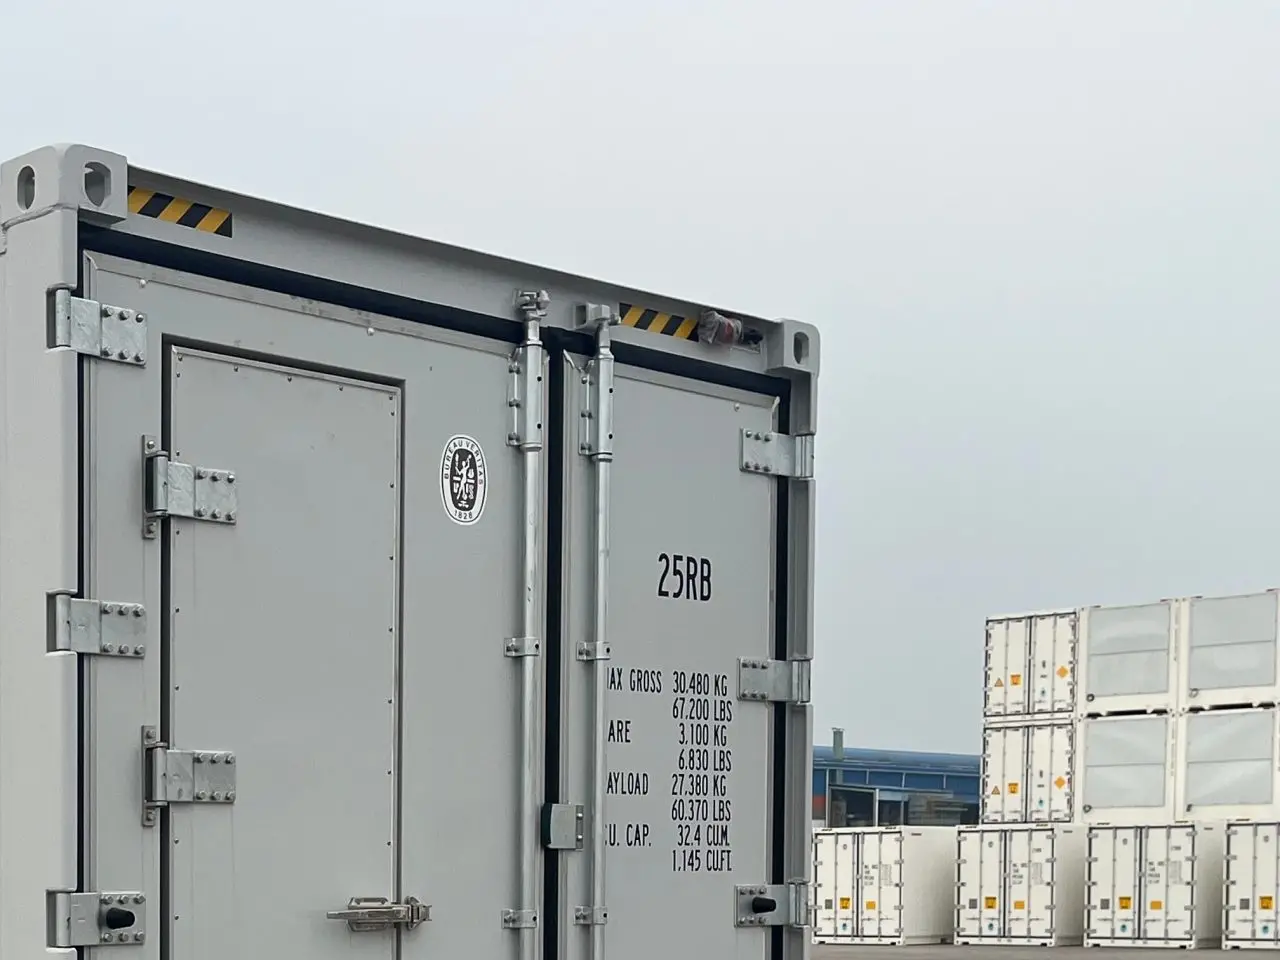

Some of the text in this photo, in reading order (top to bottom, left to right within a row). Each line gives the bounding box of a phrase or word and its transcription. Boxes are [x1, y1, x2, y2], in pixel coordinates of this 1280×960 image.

[454, 510, 473, 520] 1828
[657, 553, 712, 602] 25RB
[606, 667, 623, 691] AX
[629, 668, 662, 693] GROSS
[714, 674, 728, 697] KG
[713, 700, 733, 722] LBS
[607, 720, 631, 743] ARE
[713, 724, 728, 747] KG
[713, 750, 732, 772] LBS
[606, 772, 649, 795] AYLOAD
[713, 775, 727, 797] KG
[712, 800, 732, 822] LBS
[626, 823, 652, 847] CAP.
[677, 824, 701, 847] 32.4
